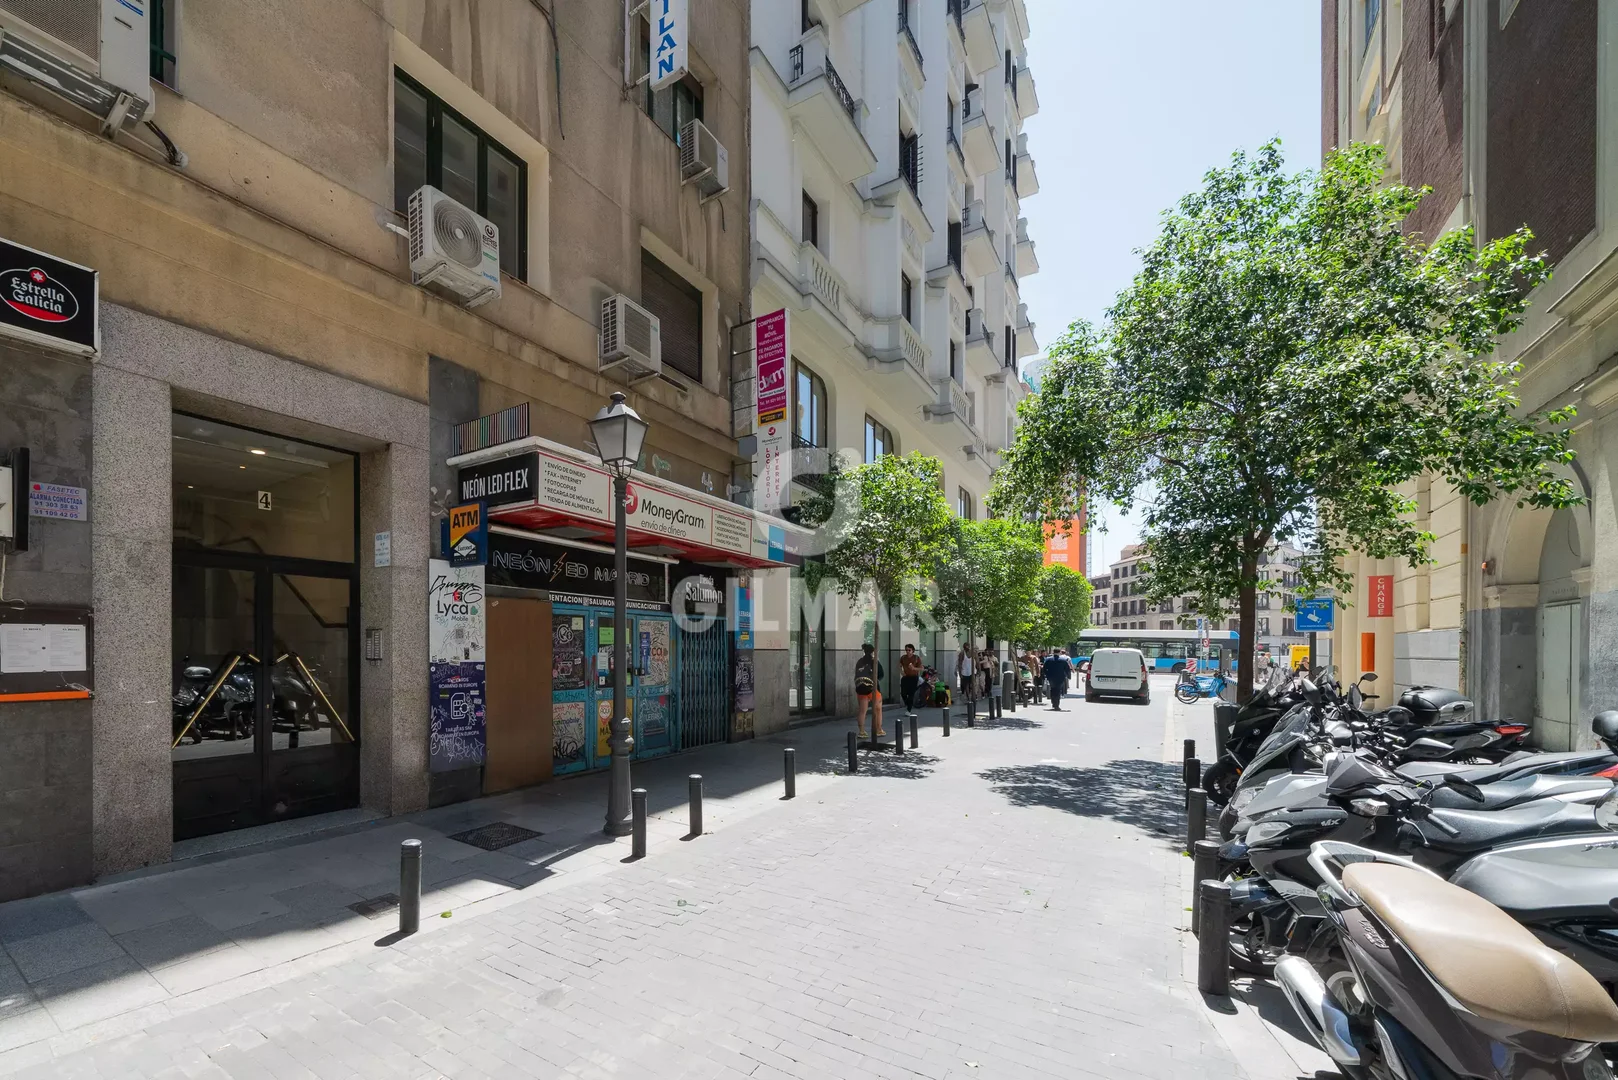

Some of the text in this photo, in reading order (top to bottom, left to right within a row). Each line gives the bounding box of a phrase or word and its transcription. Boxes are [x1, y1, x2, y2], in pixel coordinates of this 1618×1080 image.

[11, 276, 65, 303] Estrella
[12, 289, 63, 313] Galicia
[547, 461, 563, 472] ENVÍO
[562, 466, 570, 474] DE
[462, 467, 529, 501] NEÓN LED FLEX
[546, 478, 577, 492] FOTOCOPIAS
[547, 470, 557, 479] FAX
[559, 473, 582, 485] INTERNET
[29, 492, 83, 505] ALARMA CONECTADA
[46, 485, 80, 495] FASETEC
[546, 487, 570, 499] RECARGA
[259, 492, 271, 509] 4
[547, 495, 565, 506] TIENDA
[452, 509, 479, 529] ATM
[641, 498, 705, 529] MoneyGram
[641, 520, 687, 538] envío de dinero
[492, 549, 551, 574] NEÓN
[594, 566, 650, 587] MARID
[1376, 577, 1385, 616] CHANGE
[436, 599, 469, 617] Lyca
[451, 614, 469, 622] Mobile
